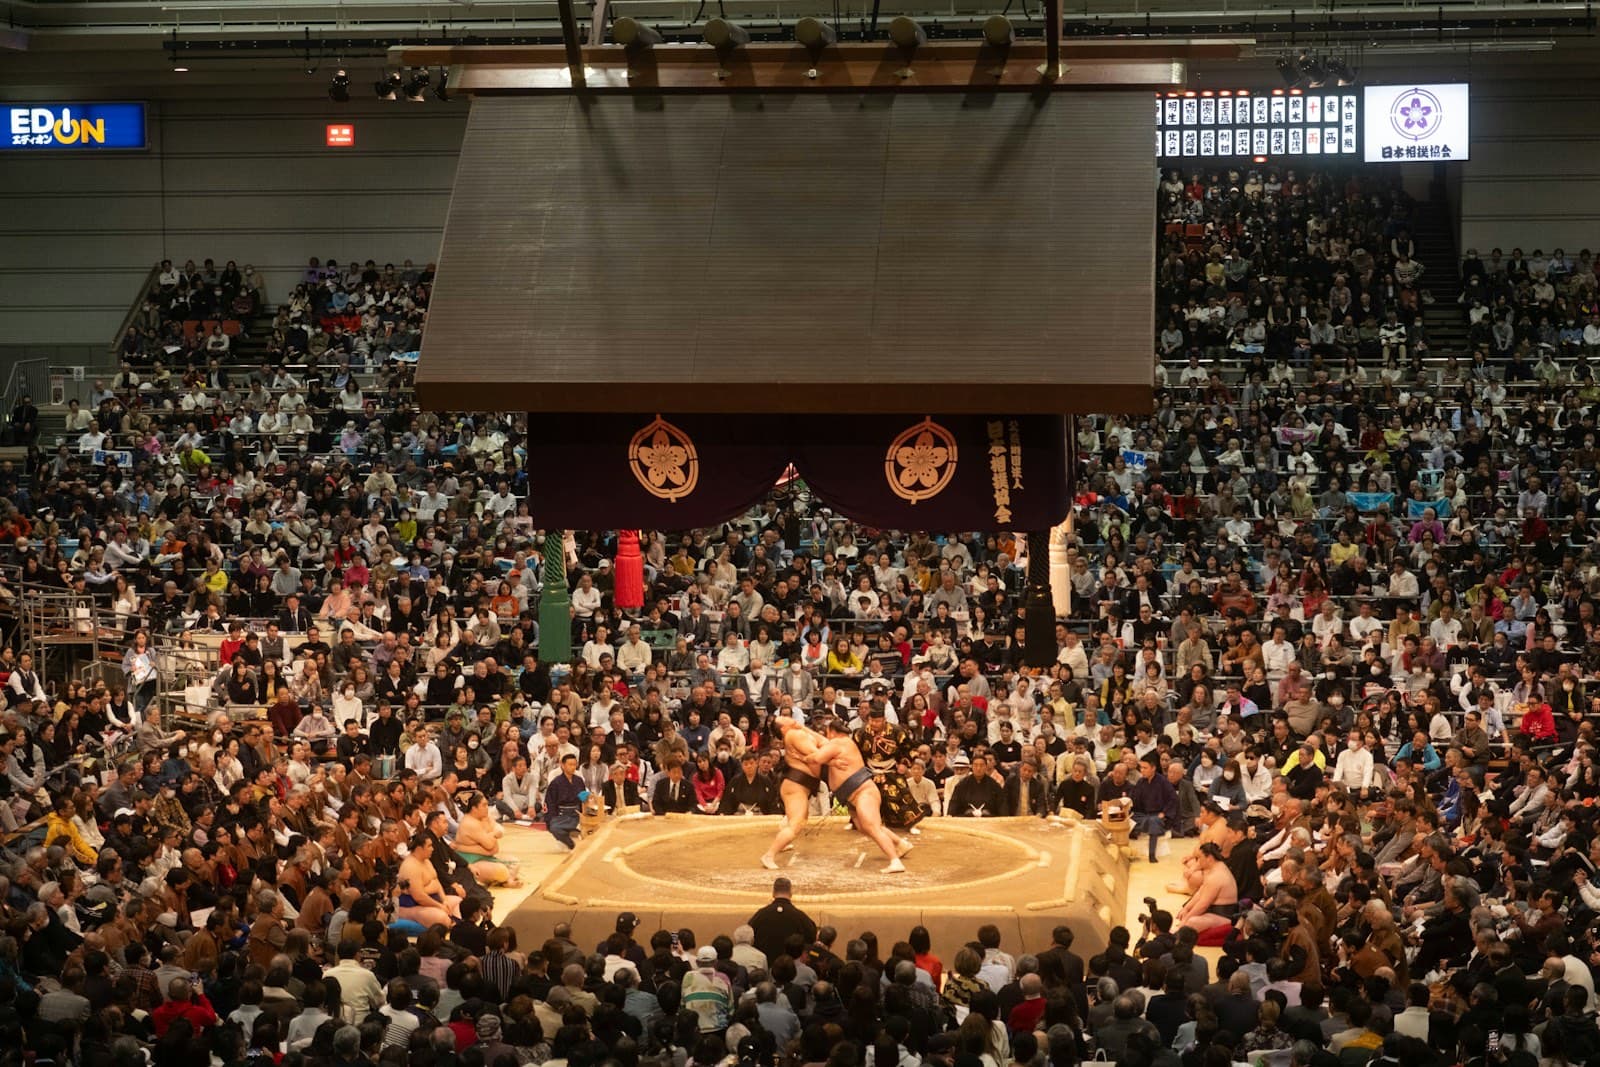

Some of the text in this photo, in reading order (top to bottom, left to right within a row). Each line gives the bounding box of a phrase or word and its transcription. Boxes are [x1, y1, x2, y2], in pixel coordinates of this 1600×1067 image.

[1168, 101, 1178, 122] 明生
[1309, 101, 1318, 114] 十
[1327, 100, 1336, 112] 東
[10, 108, 105, 144] EDION
[12, 135, 52, 144] エディオン
[1326, 132, 1336, 144] 西
[1382, 144, 1452, 158] 日本相撲協会
[988, 420, 1012, 524] 日本相撲協会
